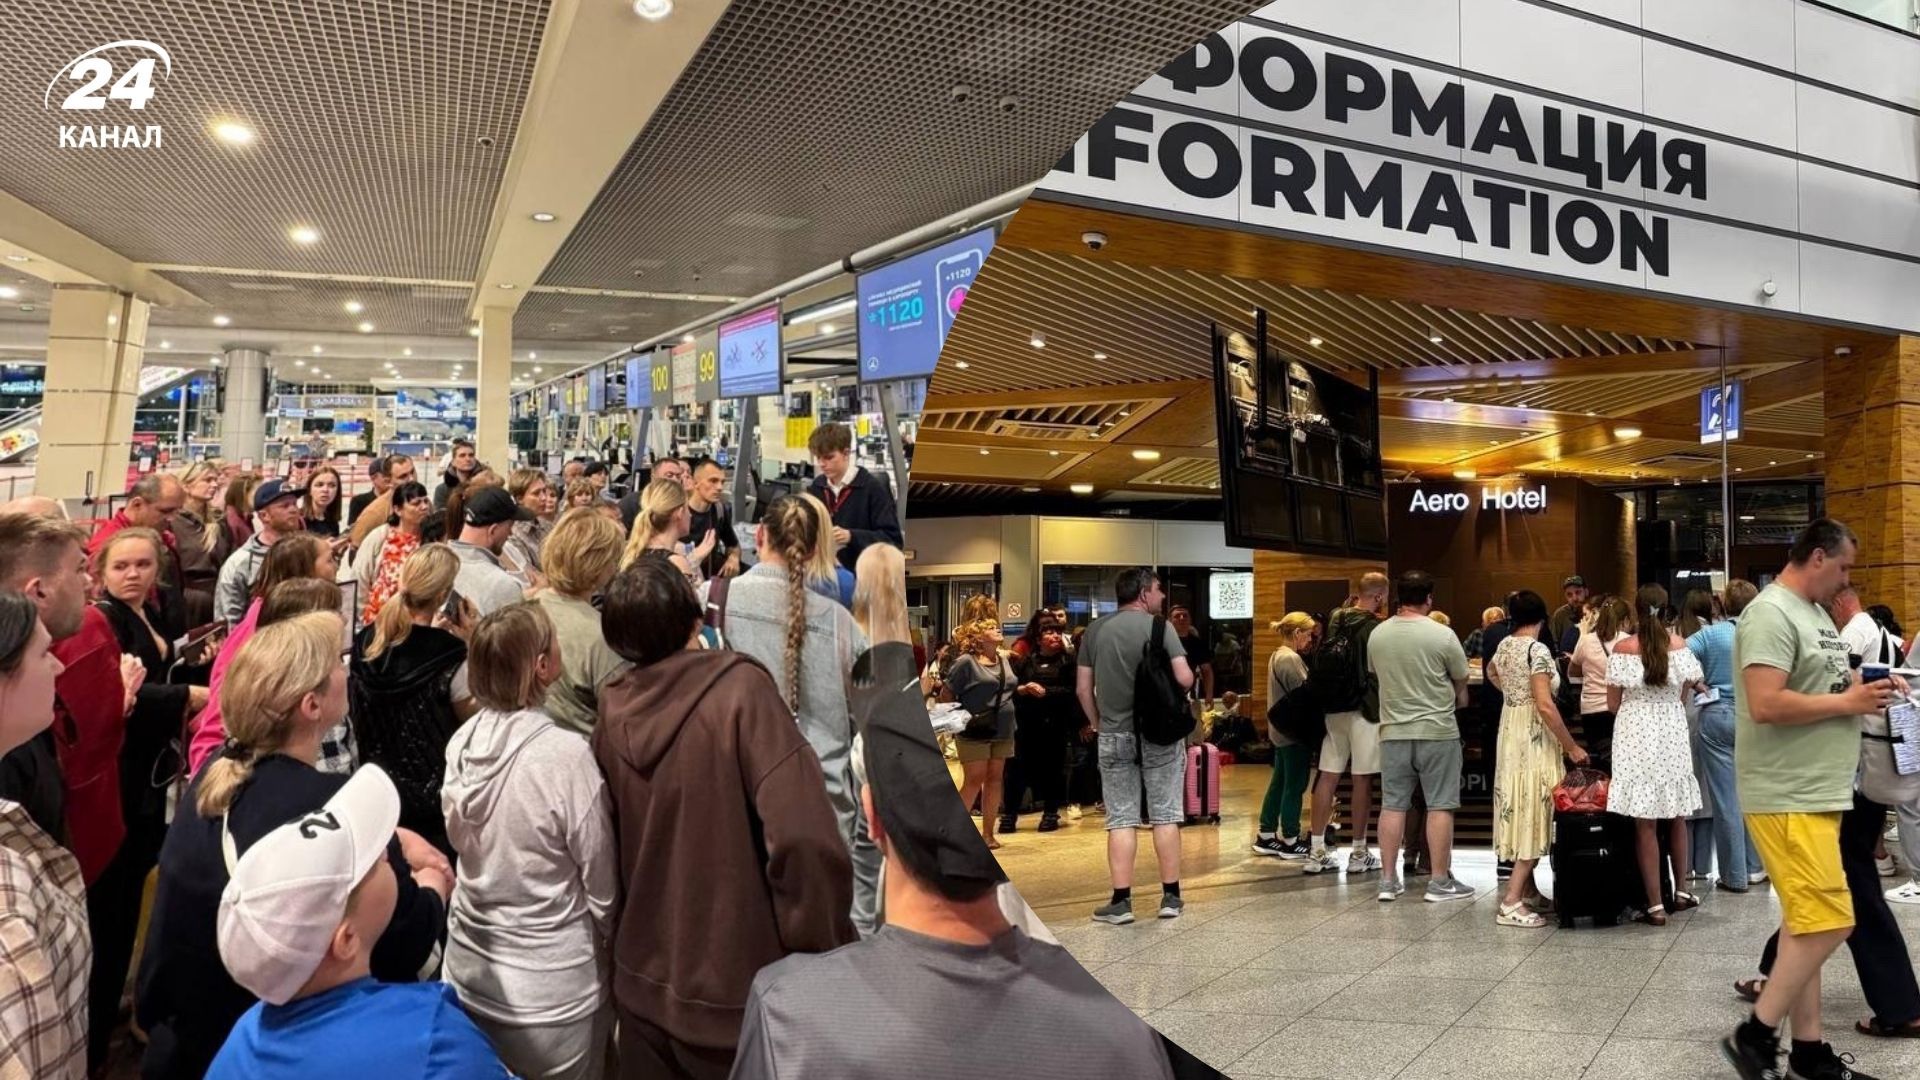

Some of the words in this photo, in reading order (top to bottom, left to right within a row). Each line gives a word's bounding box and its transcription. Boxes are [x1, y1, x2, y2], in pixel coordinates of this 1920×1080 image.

[1052, 106, 1670, 277] FORMATION
[651, 365, 669, 393] 100
[700, 351, 715, 382] 99
[1409, 489, 1470, 512] Aero
[1481, 484, 1547, 510] Hotel
